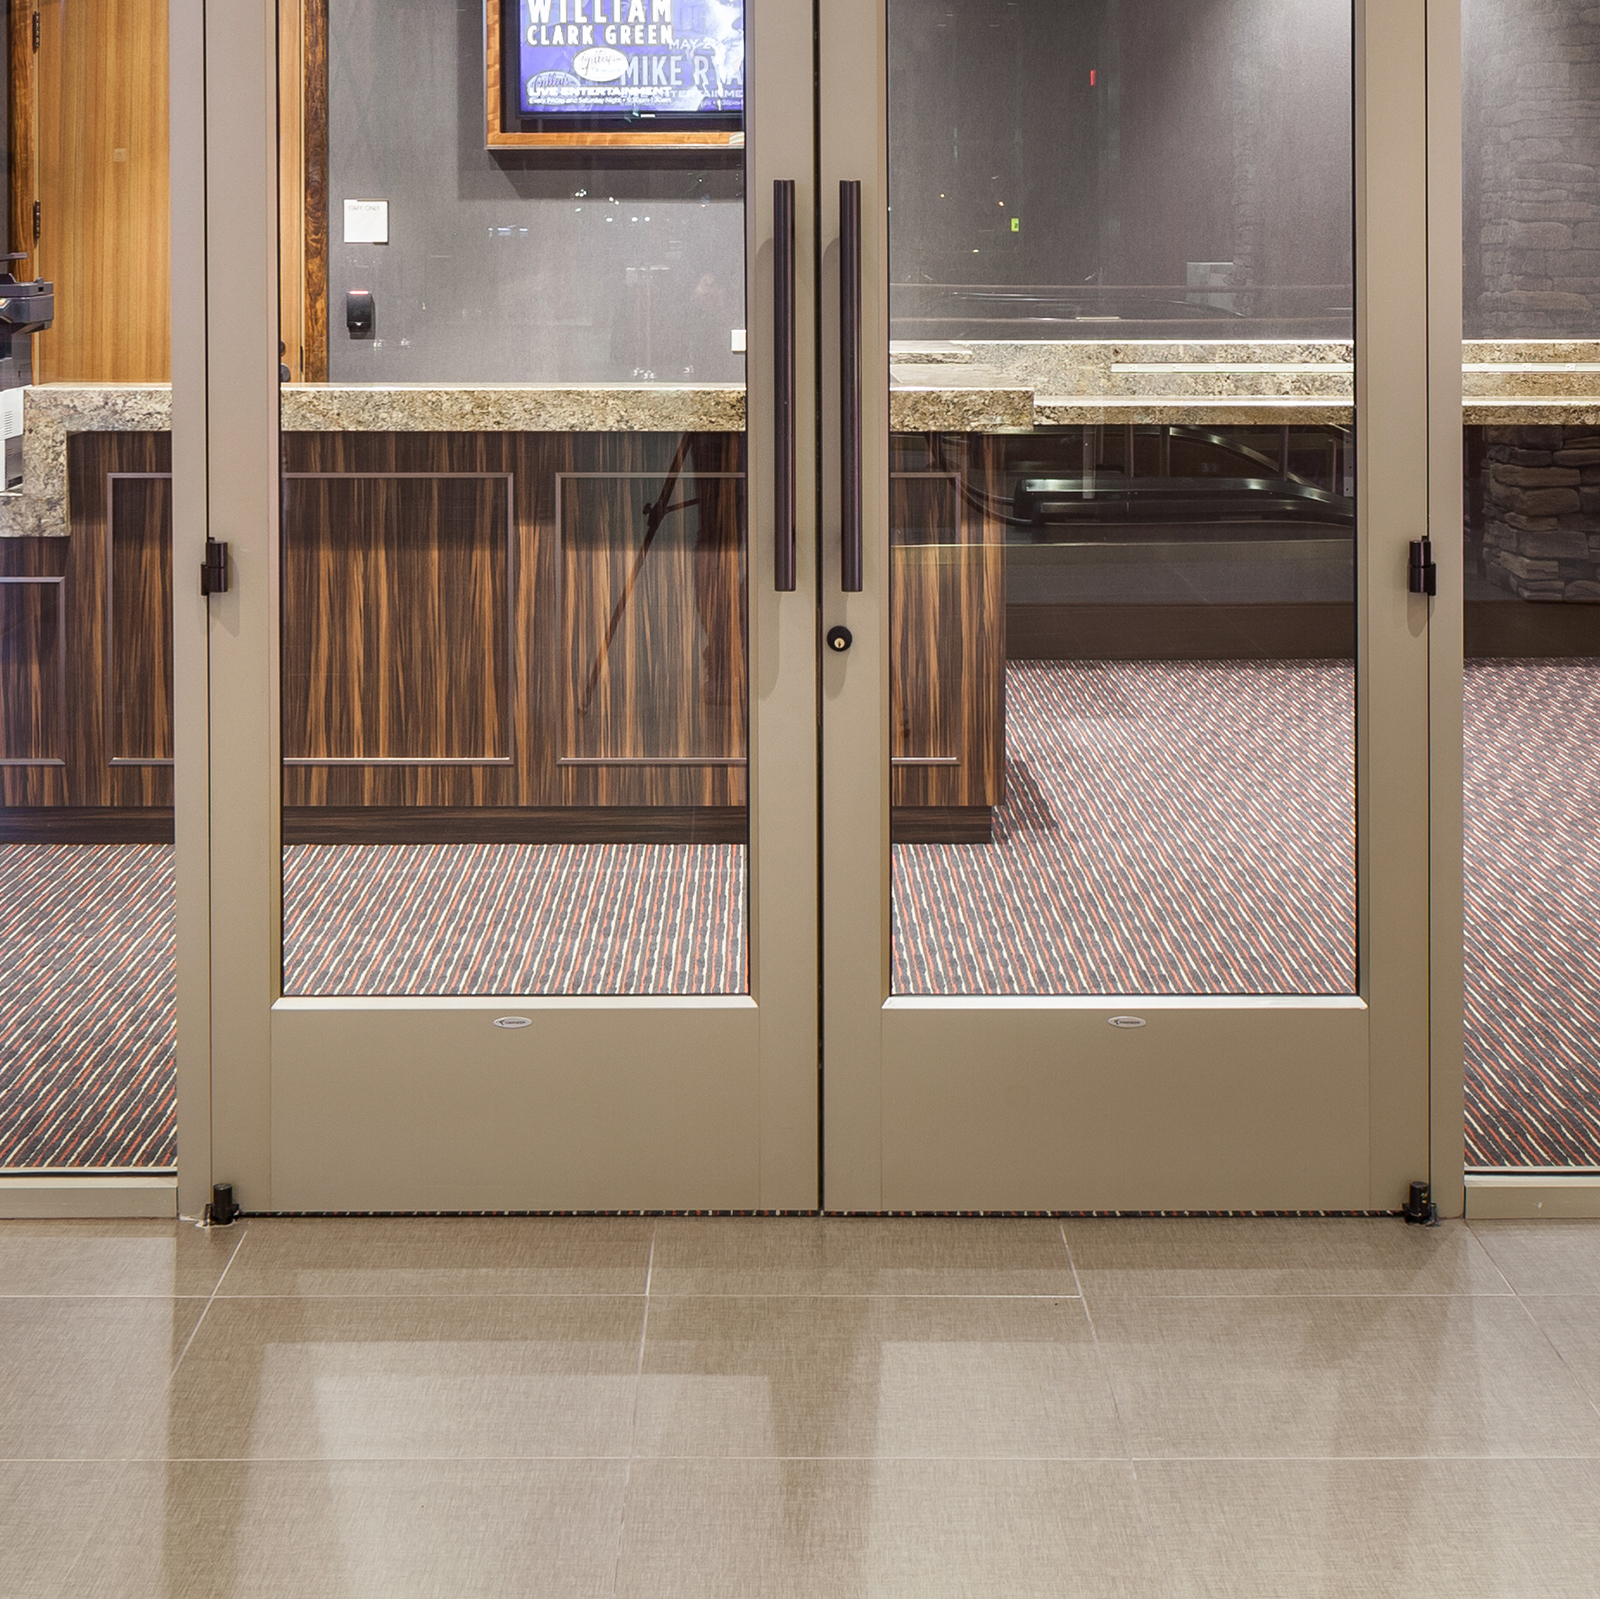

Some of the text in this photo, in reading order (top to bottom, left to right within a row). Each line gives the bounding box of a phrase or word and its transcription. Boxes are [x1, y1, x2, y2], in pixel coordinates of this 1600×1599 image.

[526, 24, 673, 45] CLARK GREEN
[621, 55, 682, 86] MIKE
